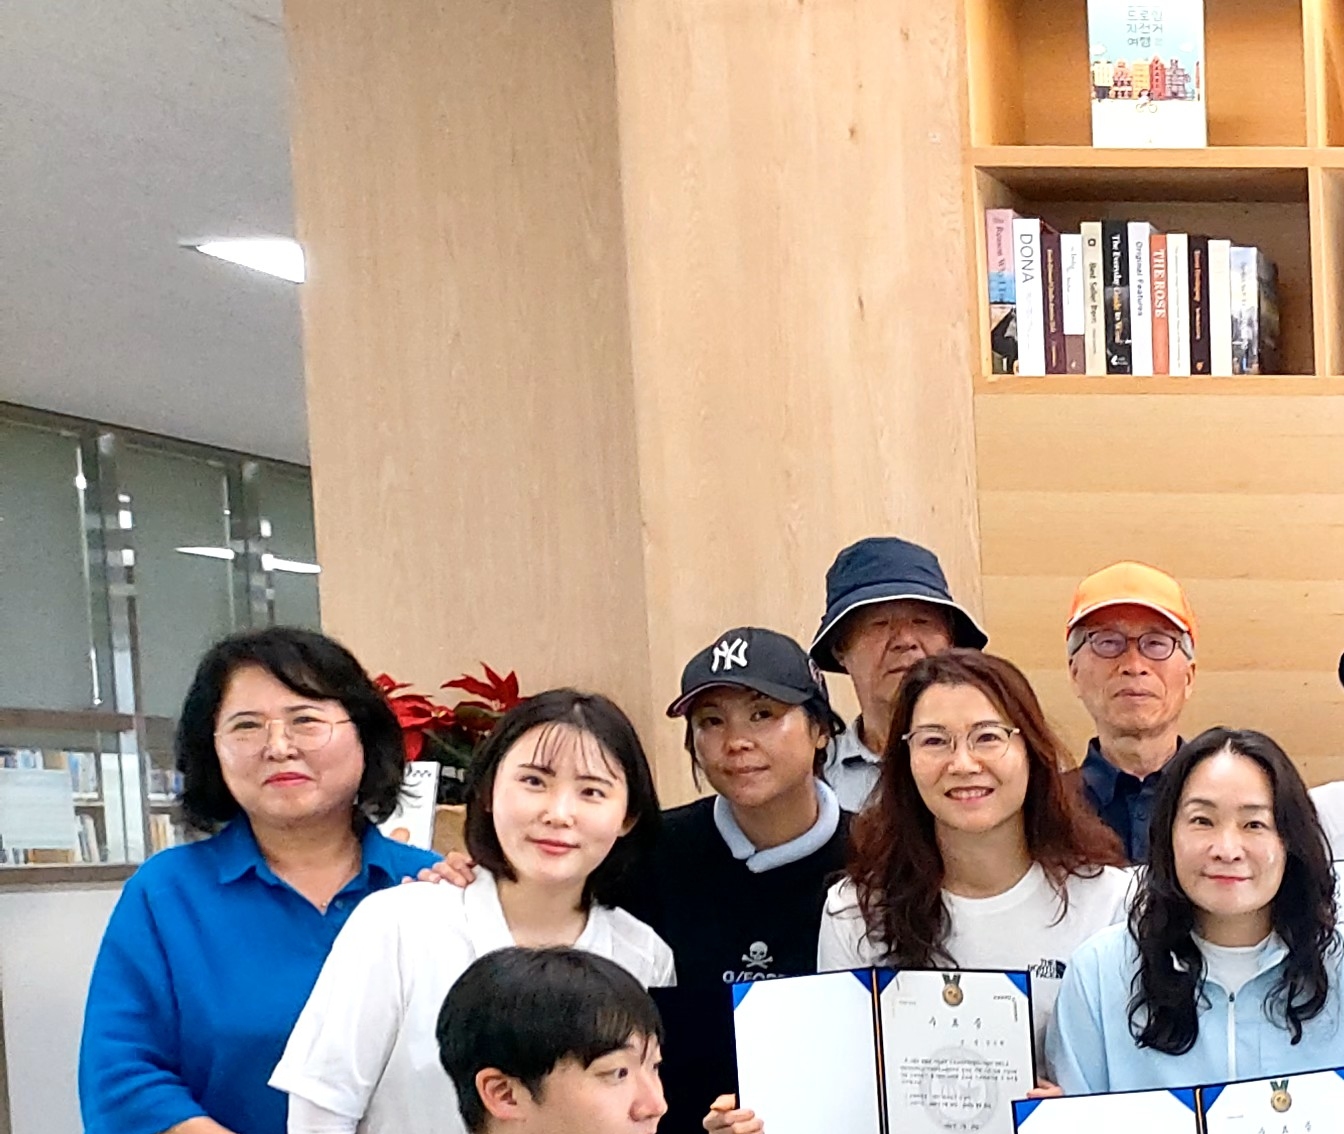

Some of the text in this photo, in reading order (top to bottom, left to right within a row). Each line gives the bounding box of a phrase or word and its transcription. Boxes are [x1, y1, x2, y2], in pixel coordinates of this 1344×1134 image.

[1020, 234, 1034, 283] DONA
[1135, 241, 1143, 276] Original
[1153, 249, 1166, 318] THE ROSE
[711, 638, 748, 671] NY
